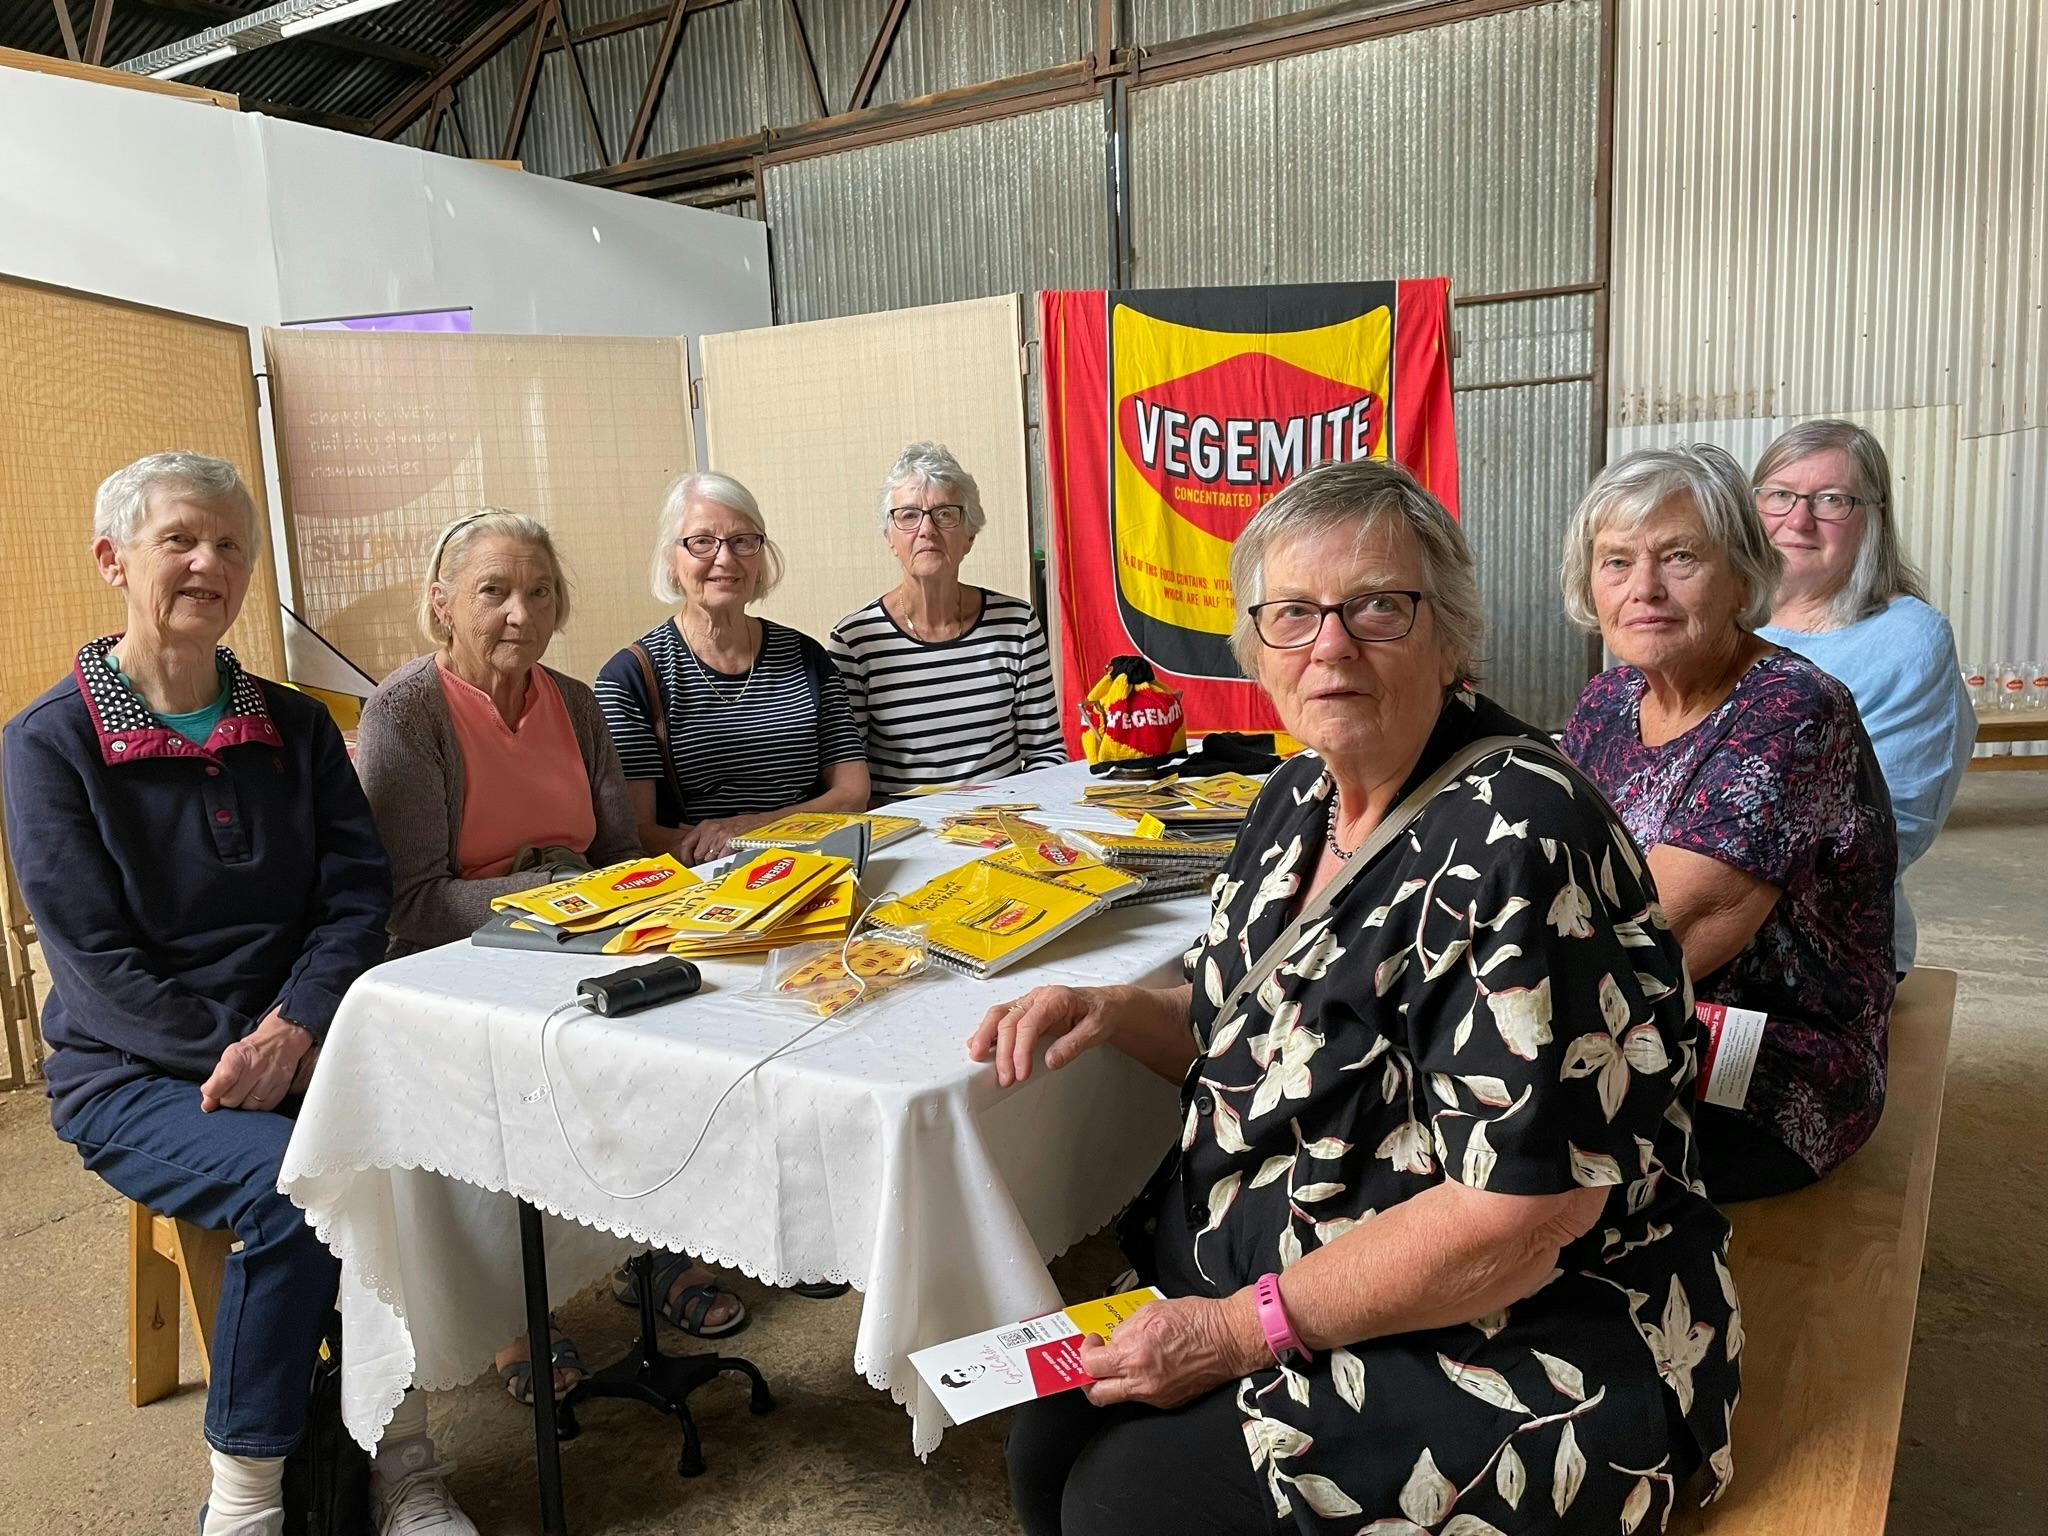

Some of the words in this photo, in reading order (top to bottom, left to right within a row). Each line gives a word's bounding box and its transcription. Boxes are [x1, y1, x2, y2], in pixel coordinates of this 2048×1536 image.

[1135, 394, 1372, 485] VEGEMITE
[310, 458, 420, 481] communities
[1174, 486, 1253, 508] CONCENTRATED
[1145, 561, 1158, 577] THIS
[1160, 567, 1175, 583] FOOD
[1213, 577, 1232, 591] VITA
[1163, 586, 1183, 602] WHICH
[1186, 591, 1199, 606] ARE
[1203, 594, 1220, 608] HALF
[615, 870, 674, 891] VEGEMITE
[747, 857, 795, 889] VEGEMITE
[909, 891, 942, 910] TASTES
[937, 881, 960, 893] LIKE
[926, 885, 964, 911] AUSTRALIA
